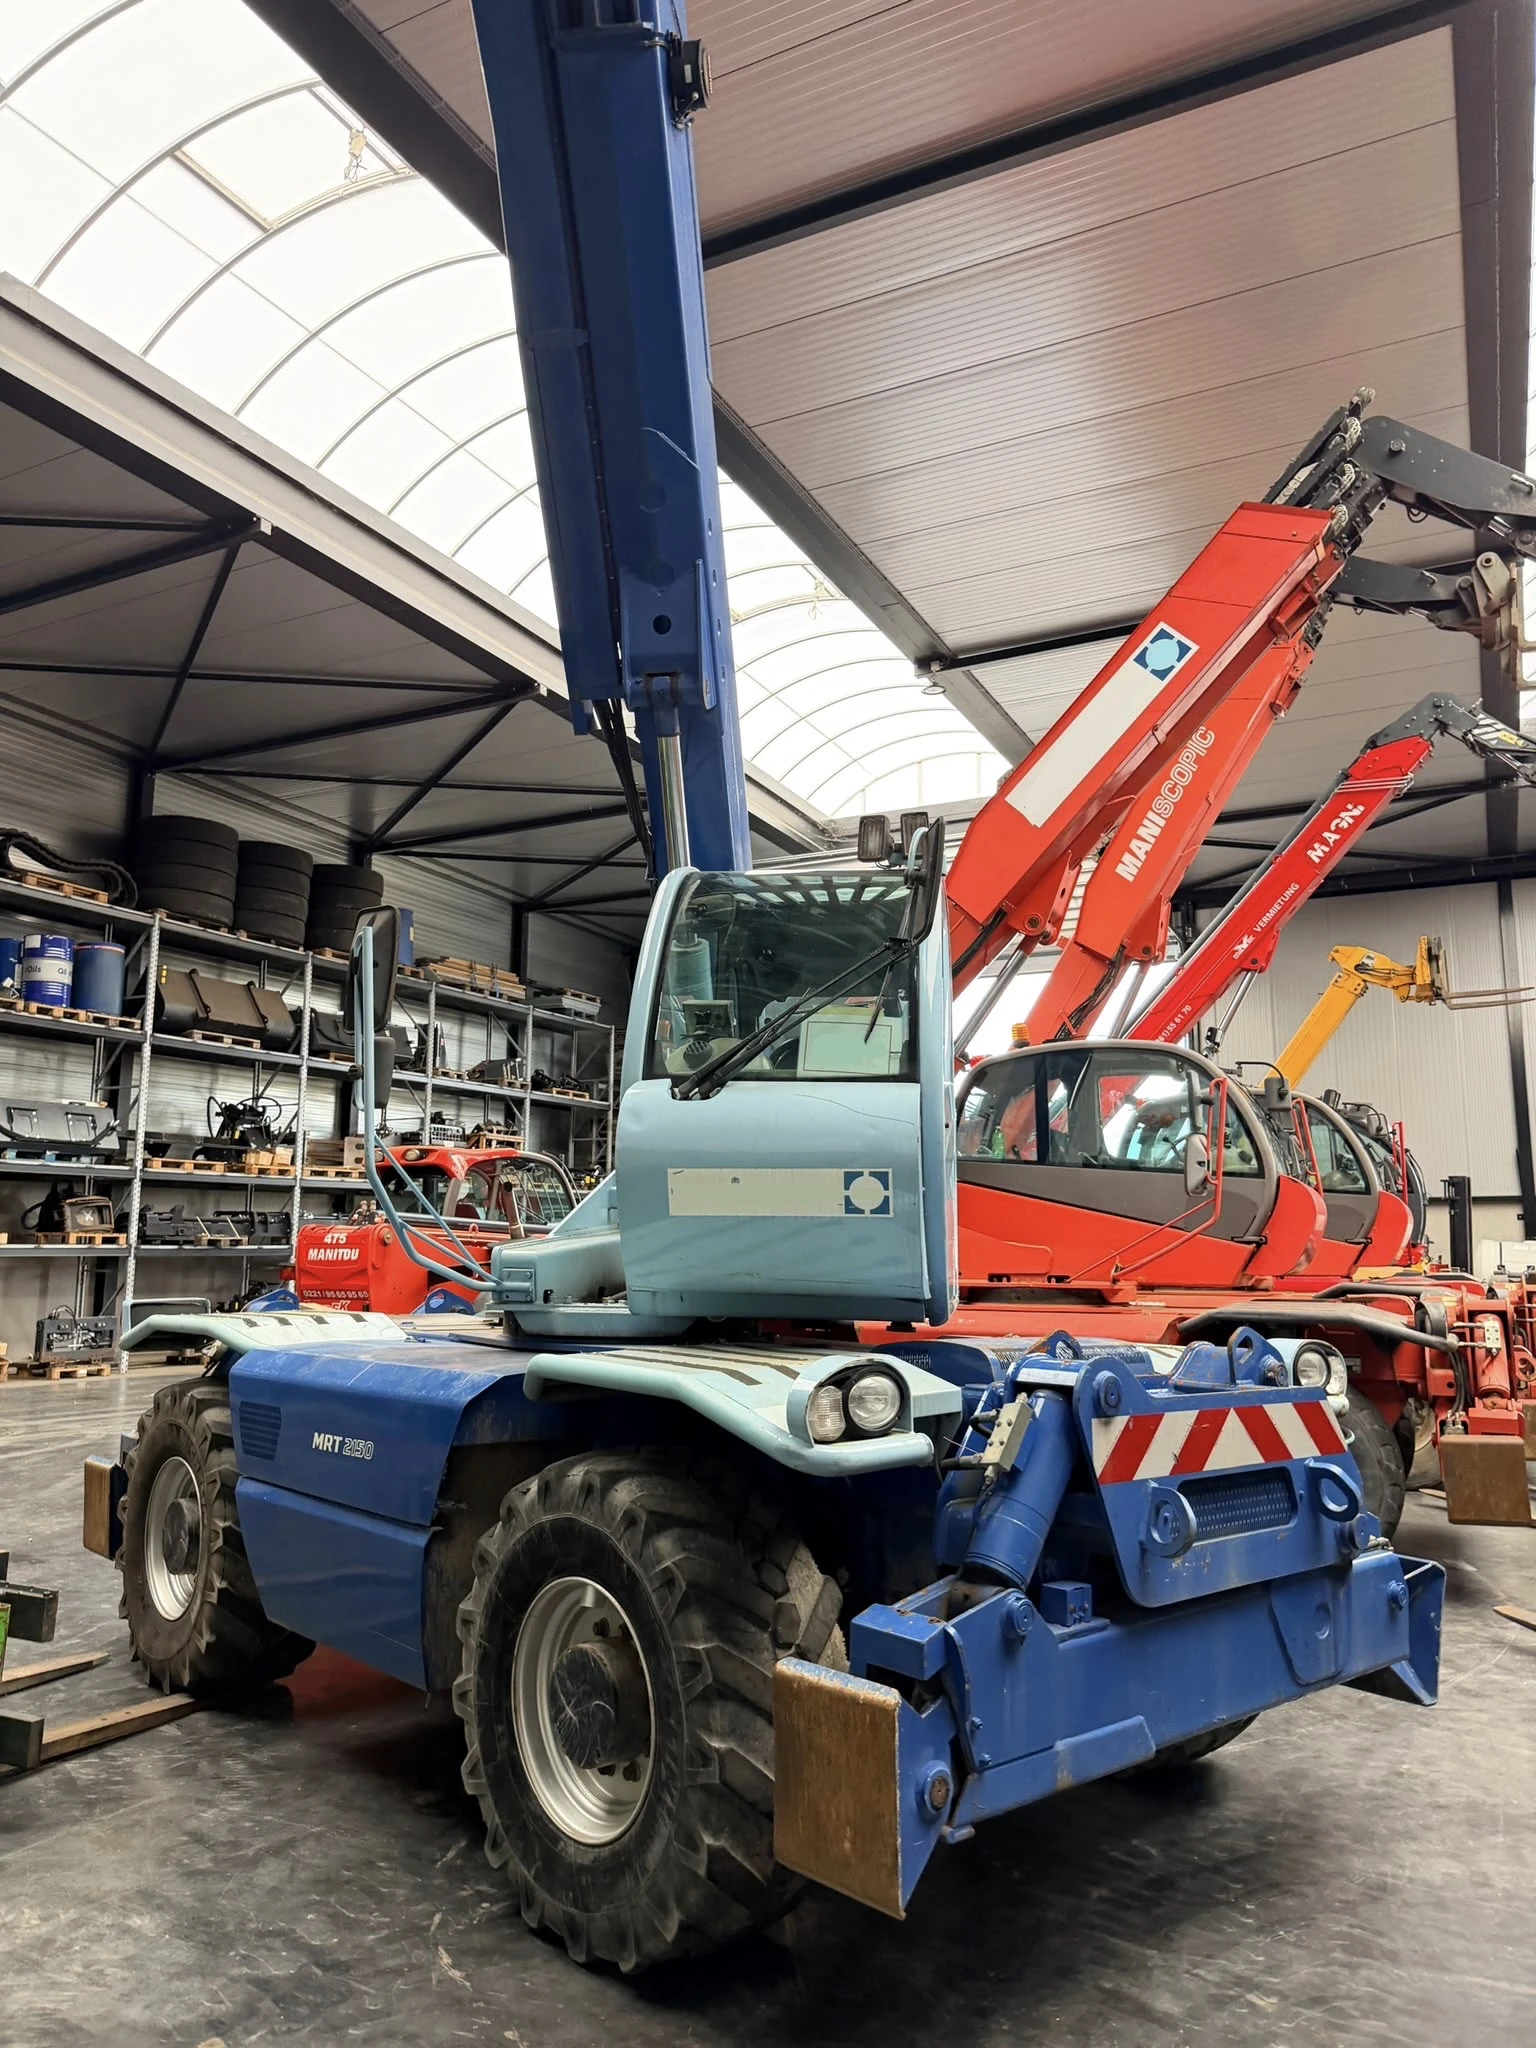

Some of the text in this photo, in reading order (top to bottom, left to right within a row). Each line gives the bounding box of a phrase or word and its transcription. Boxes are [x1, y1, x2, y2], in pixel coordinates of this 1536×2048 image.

[1115, 725, 1215, 882] MANISCOPIC
[1253, 882, 1300, 932] VERMIETUNG
[1173, 1013, 1185, 1023] 61
[1181, 1004, 1192, 1015] 70
[323, 1233, 348, 1244] 475
[307, 1248, 360, 1261] MANITOU
[312, 1431, 375, 1460] MRT 2150
